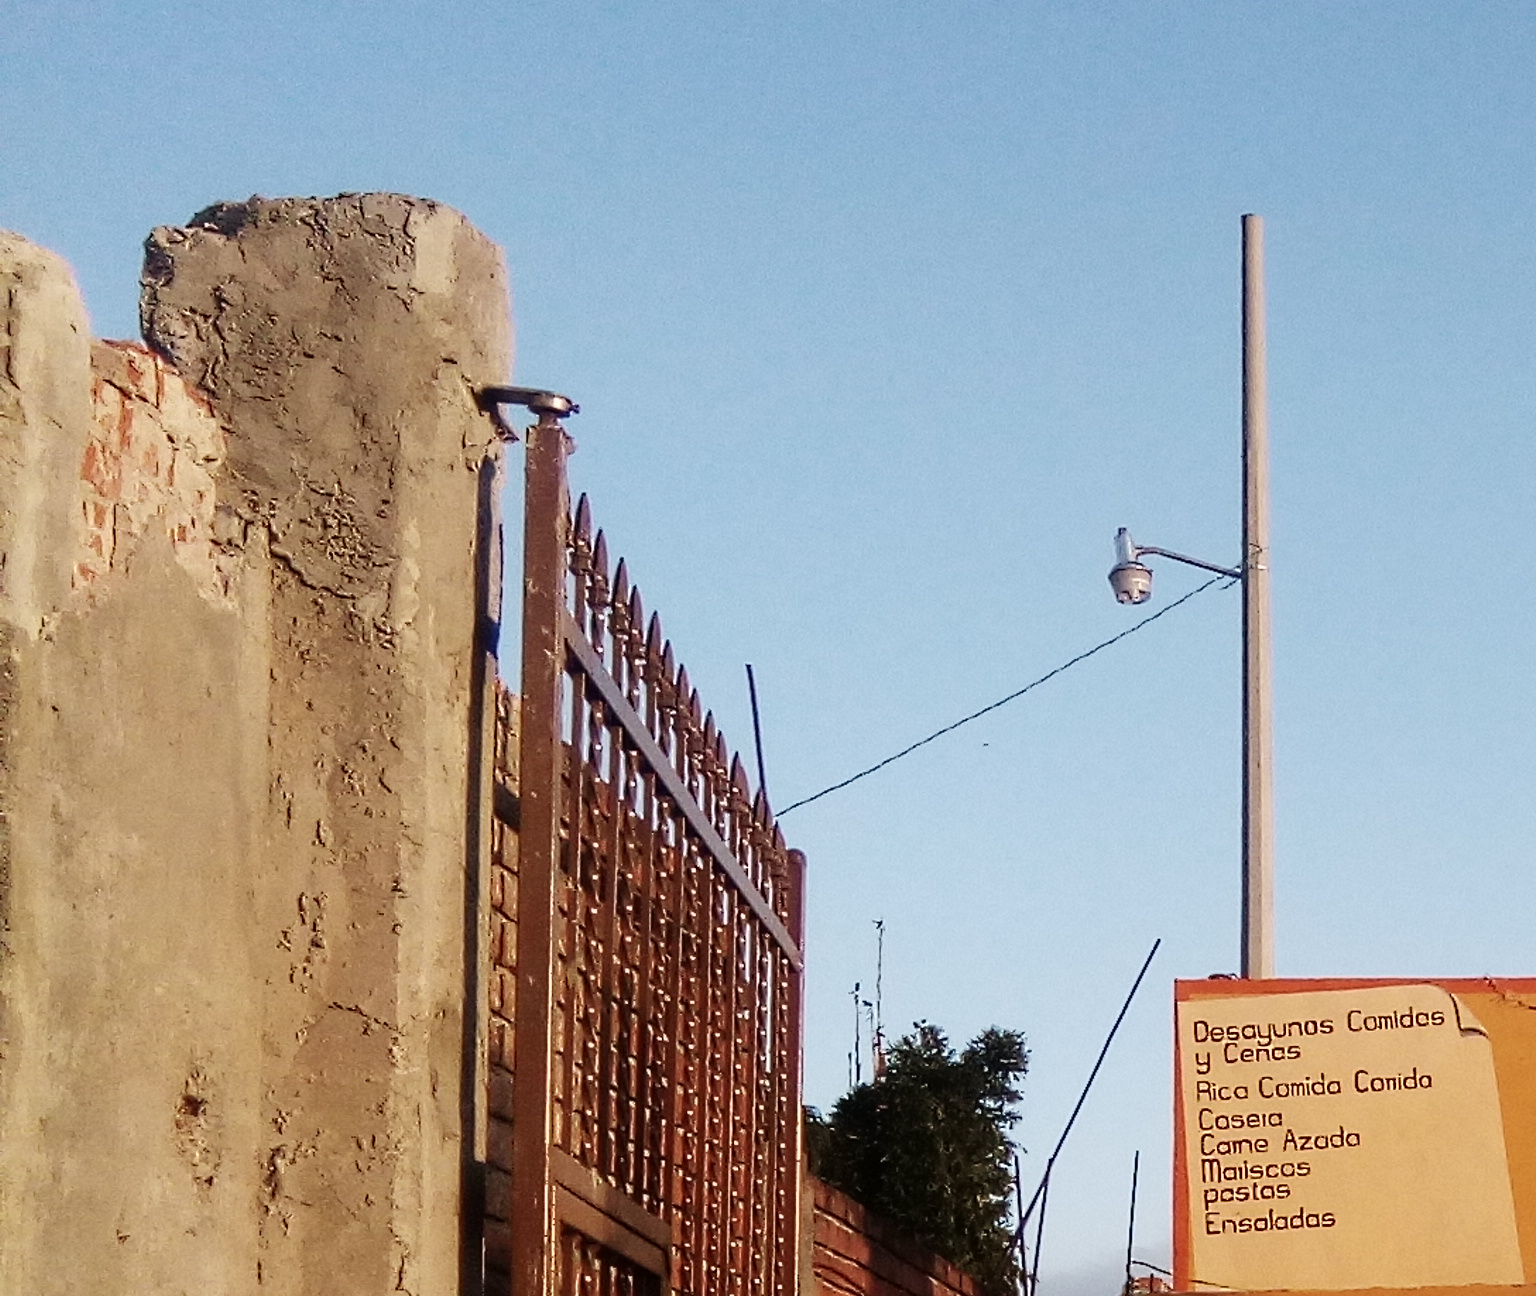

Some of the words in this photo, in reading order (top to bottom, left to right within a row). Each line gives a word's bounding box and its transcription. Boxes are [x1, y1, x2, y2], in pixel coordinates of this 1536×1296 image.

[1193, 1019, 1334, 1047] Desayunos
[1347, 1006, 1445, 1032] Comidas
[1195, 1050, 1211, 1075] y
[1223, 1042, 1301, 1064] Cenas
[1197, 1080, 1249, 1103] Rica
[1258, 1073, 1342, 1099] Comida
[1282, 1125, 1361, 1152] Azada
[1203, 1182, 1292, 1211] pastas
[1205, 1206, 1337, 1236] Ensaladas
